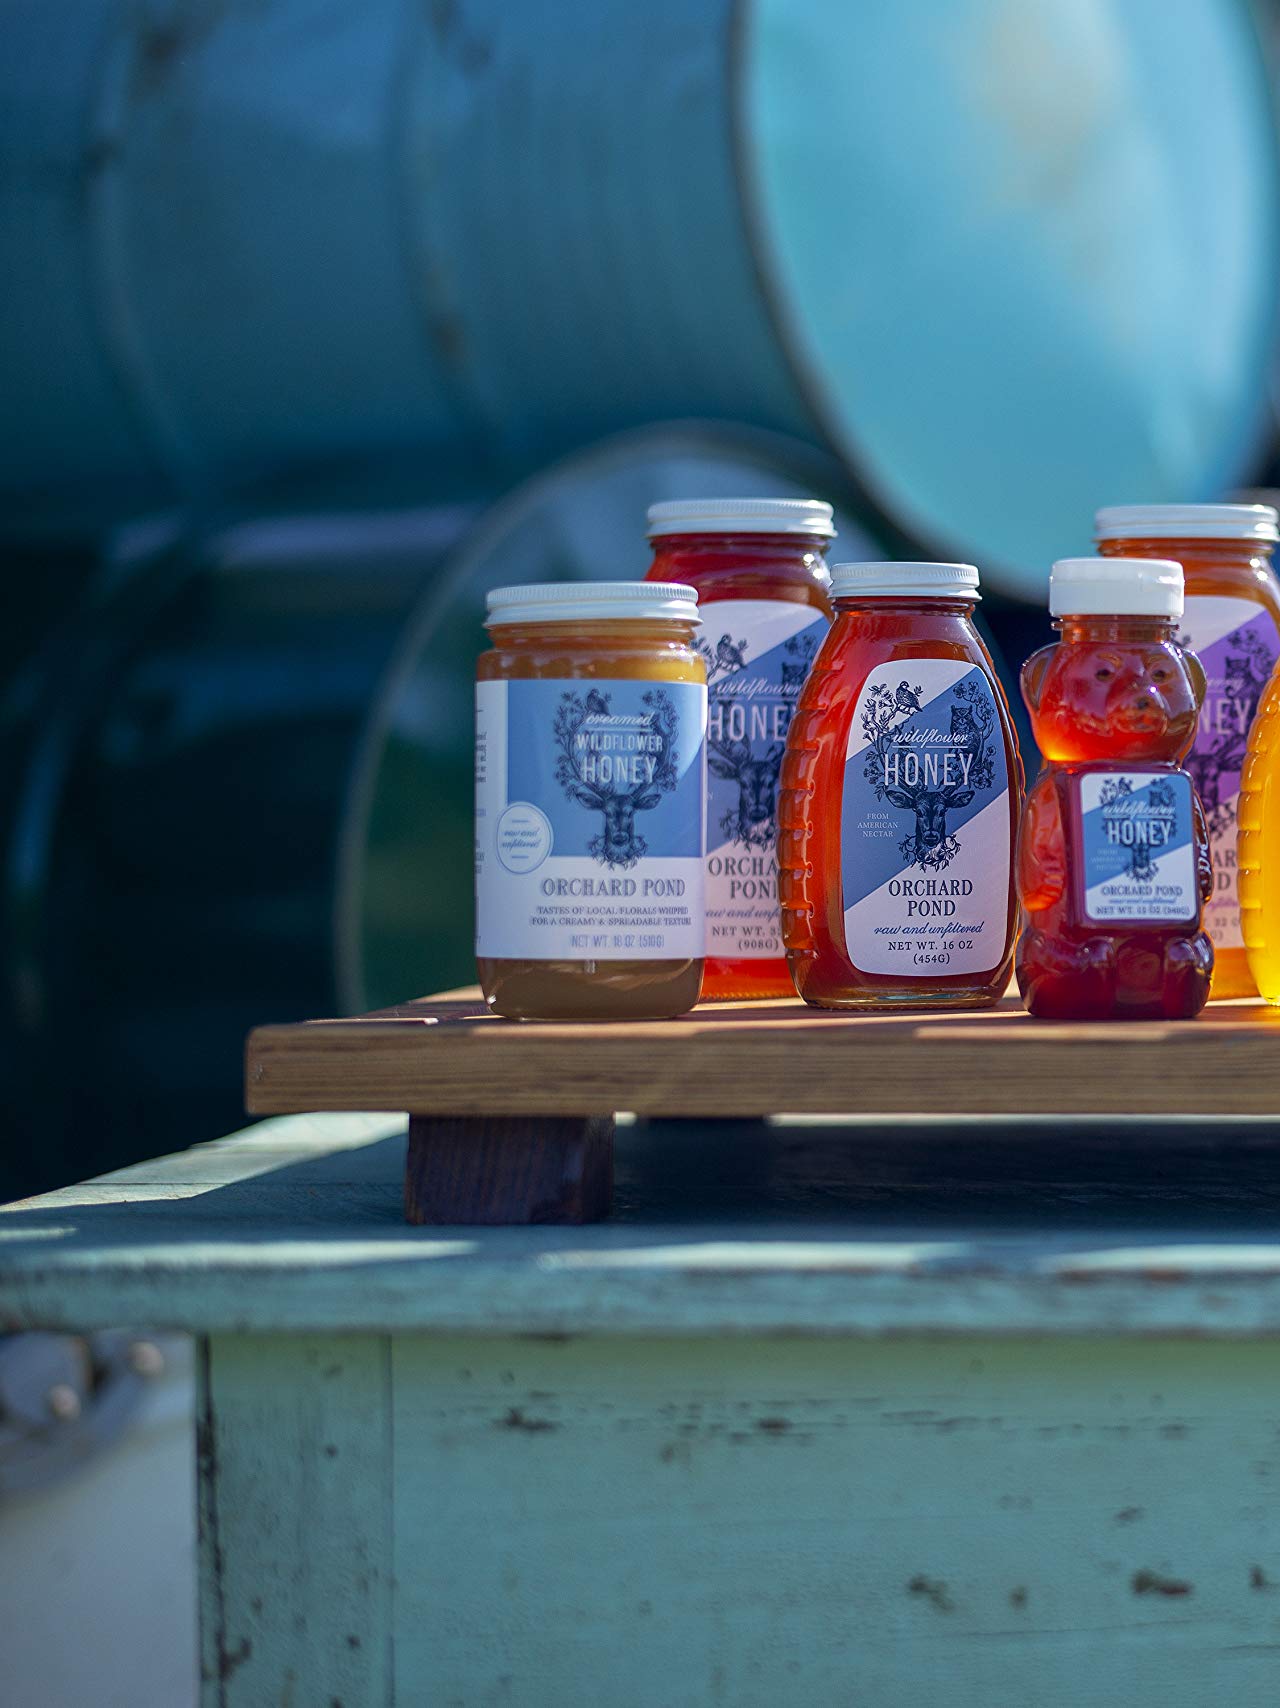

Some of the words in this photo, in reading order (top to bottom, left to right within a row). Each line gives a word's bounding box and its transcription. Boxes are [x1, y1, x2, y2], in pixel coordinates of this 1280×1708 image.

[716, 677, 801, 700] wildflower
[585, 711, 655, 725] creamed
[708, 704, 797, 742] HONE
[1197, 699, 1251, 735] NEY
[576, 733, 663, 751] WILDFLOWER
[893, 729, 969, 749] wildflower
[581, 756, 657, 784] HONEY
[884, 753, 974, 786] HONEY
[857, 821, 899, 829] AMERICAN
[1107, 820, 1172, 845] HONEY
[862, 830, 894, 838] NECTAR
[708, 856, 779, 877] ORCHA
[542, 878, 637, 897] ORCHARD
[643, 878, 686, 897] POND
[730, 880, 777, 899] PON
[888, 879, 974, 897] ORCHARD
[537, 906, 570, 915] TASTES
[572, 906, 585, 915] OF
[587, 906, 618, 915] LOCAL
[619, 906, 657, 915] FLORALS
[658, 906, 689, 915] WHIPPED
[705, 907, 726, 918] aw
[727, 906, 755, 918] and
[907, 900, 957, 917] POND
[531, 916, 549, 926] FOR
[558, 916, 596, 925] CREAMY
[608, 916, 662, 926] SPREADABLE
[663, 916, 692, 926] TEXTURE
[874, 925, 902, 935] raw
[902, 922, 930, 935] and
[928, 921, 985, 938] unfiltered
[712, 926, 737, 937] NET
[742, 926, 766, 937] WT.
[571, 935, 590, 948] NET
[738, 939, 779, 952] (908G)
[888, 941, 913, 951] NET
[916, 941, 938, 951] WT.
[943, 941, 955, 950] 16
[958, 940, 974, 950] OZ
[913, 953, 951, 965] (454G)
